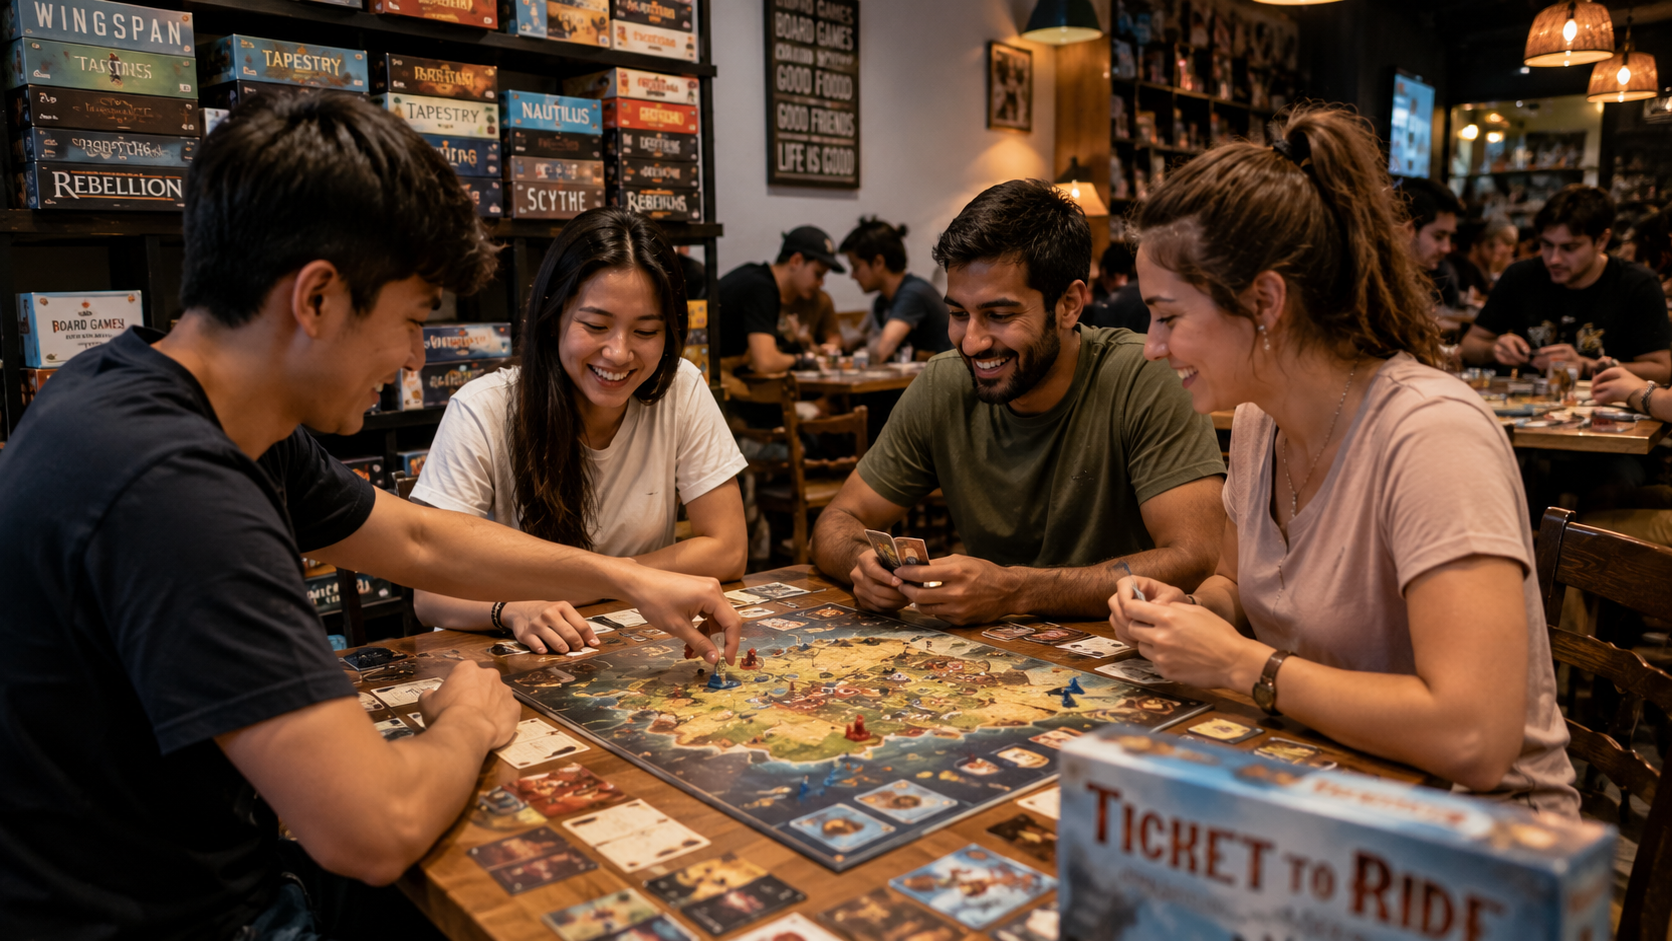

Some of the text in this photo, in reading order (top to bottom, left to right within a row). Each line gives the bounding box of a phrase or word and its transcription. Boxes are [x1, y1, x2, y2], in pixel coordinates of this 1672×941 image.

[34, 1, 181, 46] WINGSPAN
[775, 11, 854, 51] BOARD GAMES
[262, 49, 341, 77] TAPESTRY
[776, 64, 812, 95] GOOD
[406, 102, 480, 123] TAPESTRY
[522, 100, 590, 125] NAUTILUS
[777, 142, 805, 172] LIFE
[806, 144, 821, 173] IS
[52, 171, 183, 200] REBELLION
[527, 187, 588, 212] SCYTHE
[52, 318, 87, 333] BOARD
[1085, 782, 1275, 893] TICKET
[1283, 853, 1336, 903] TO
